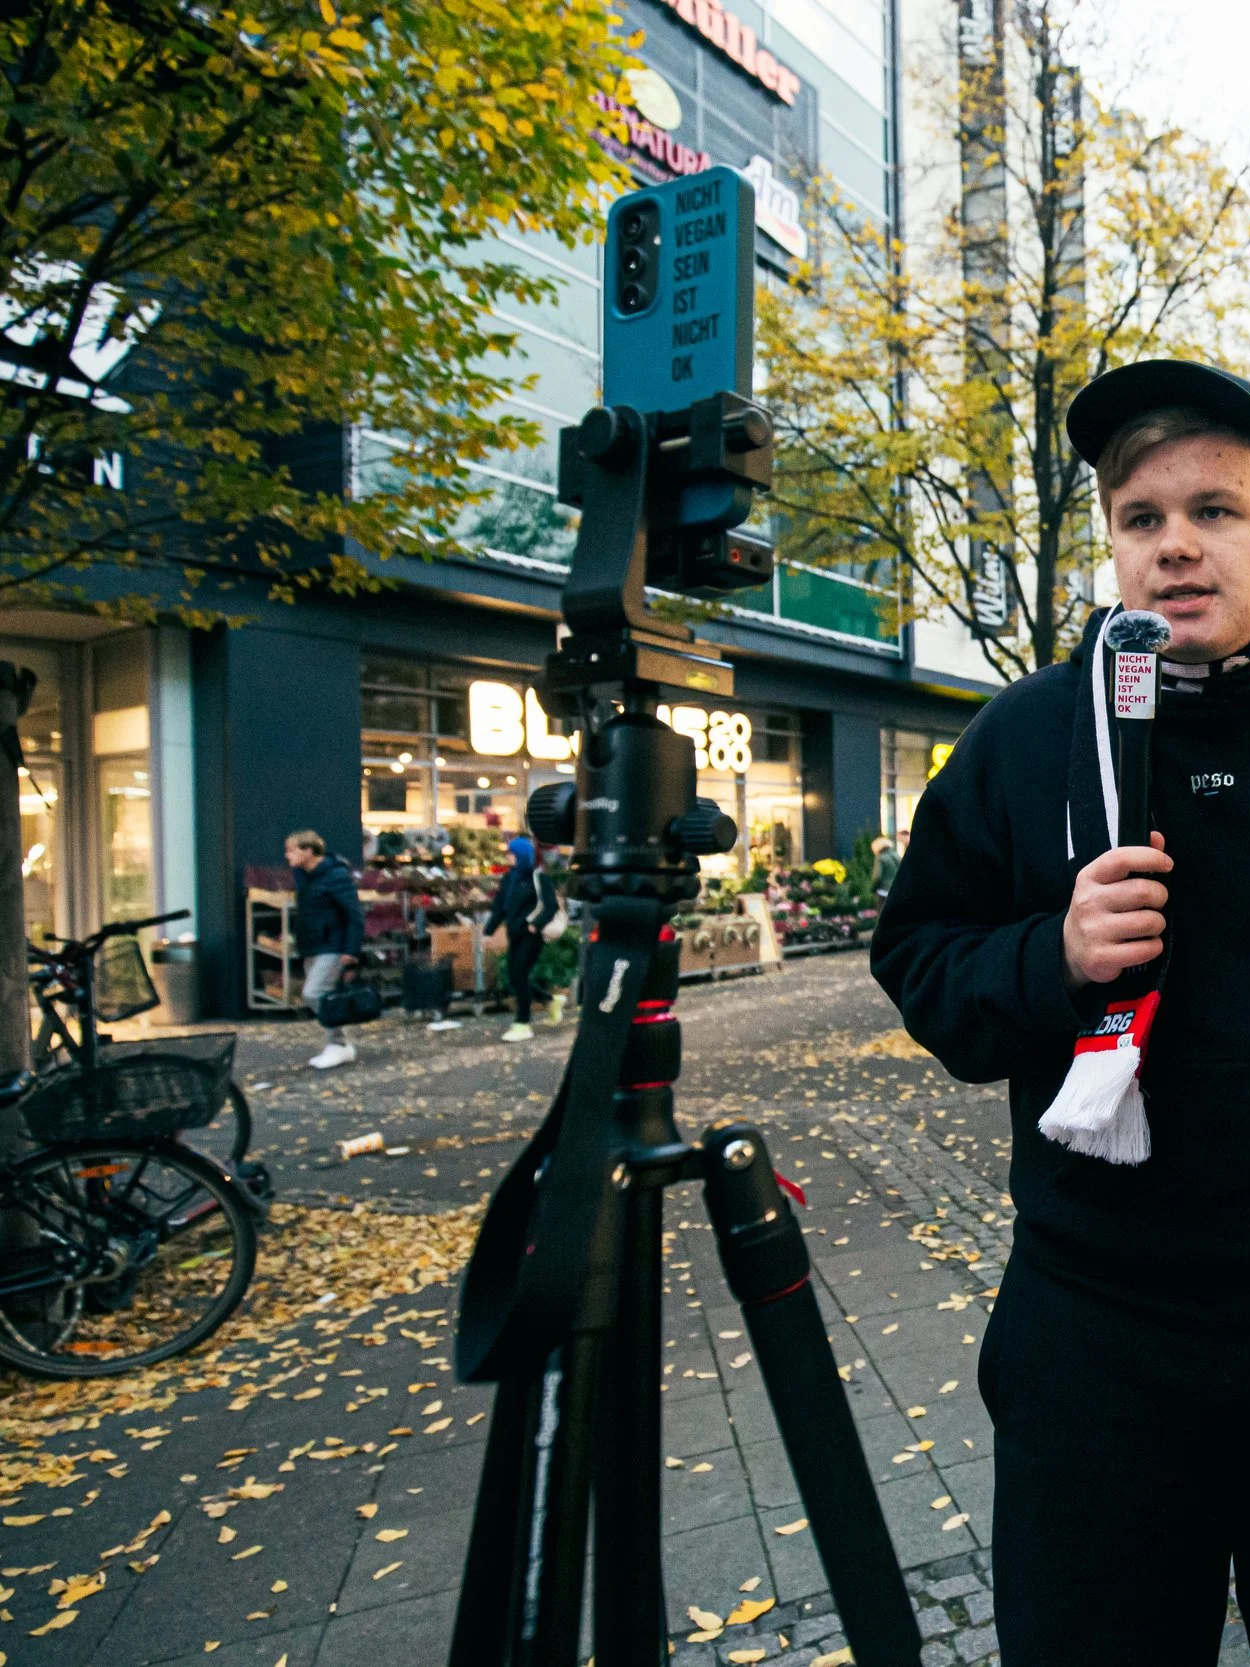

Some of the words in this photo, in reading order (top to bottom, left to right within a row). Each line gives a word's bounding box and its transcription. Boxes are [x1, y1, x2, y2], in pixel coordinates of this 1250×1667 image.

[675, 179, 721, 216] NICHT
[674, 213, 727, 248] VEGAN
[673, 251, 710, 282] SEIN
[673, 287, 698, 316] IST
[672, 313, 720, 349] NICHT
[671, 355, 694, 383] OK
[1118, 655, 1149, 664] NICHT
[1118, 665, 1152, 674] VEGAN
[1118, 674, 1141, 683] SEIN
[1118, 684, 1134, 693] IST
[1117, 694, 1148, 704] NICHT
[1117, 704, 1132, 713] OK
[708, 710, 752, 745] 20
[708, 741, 752, 773] 00
[1190, 771, 1235, 794] peso
